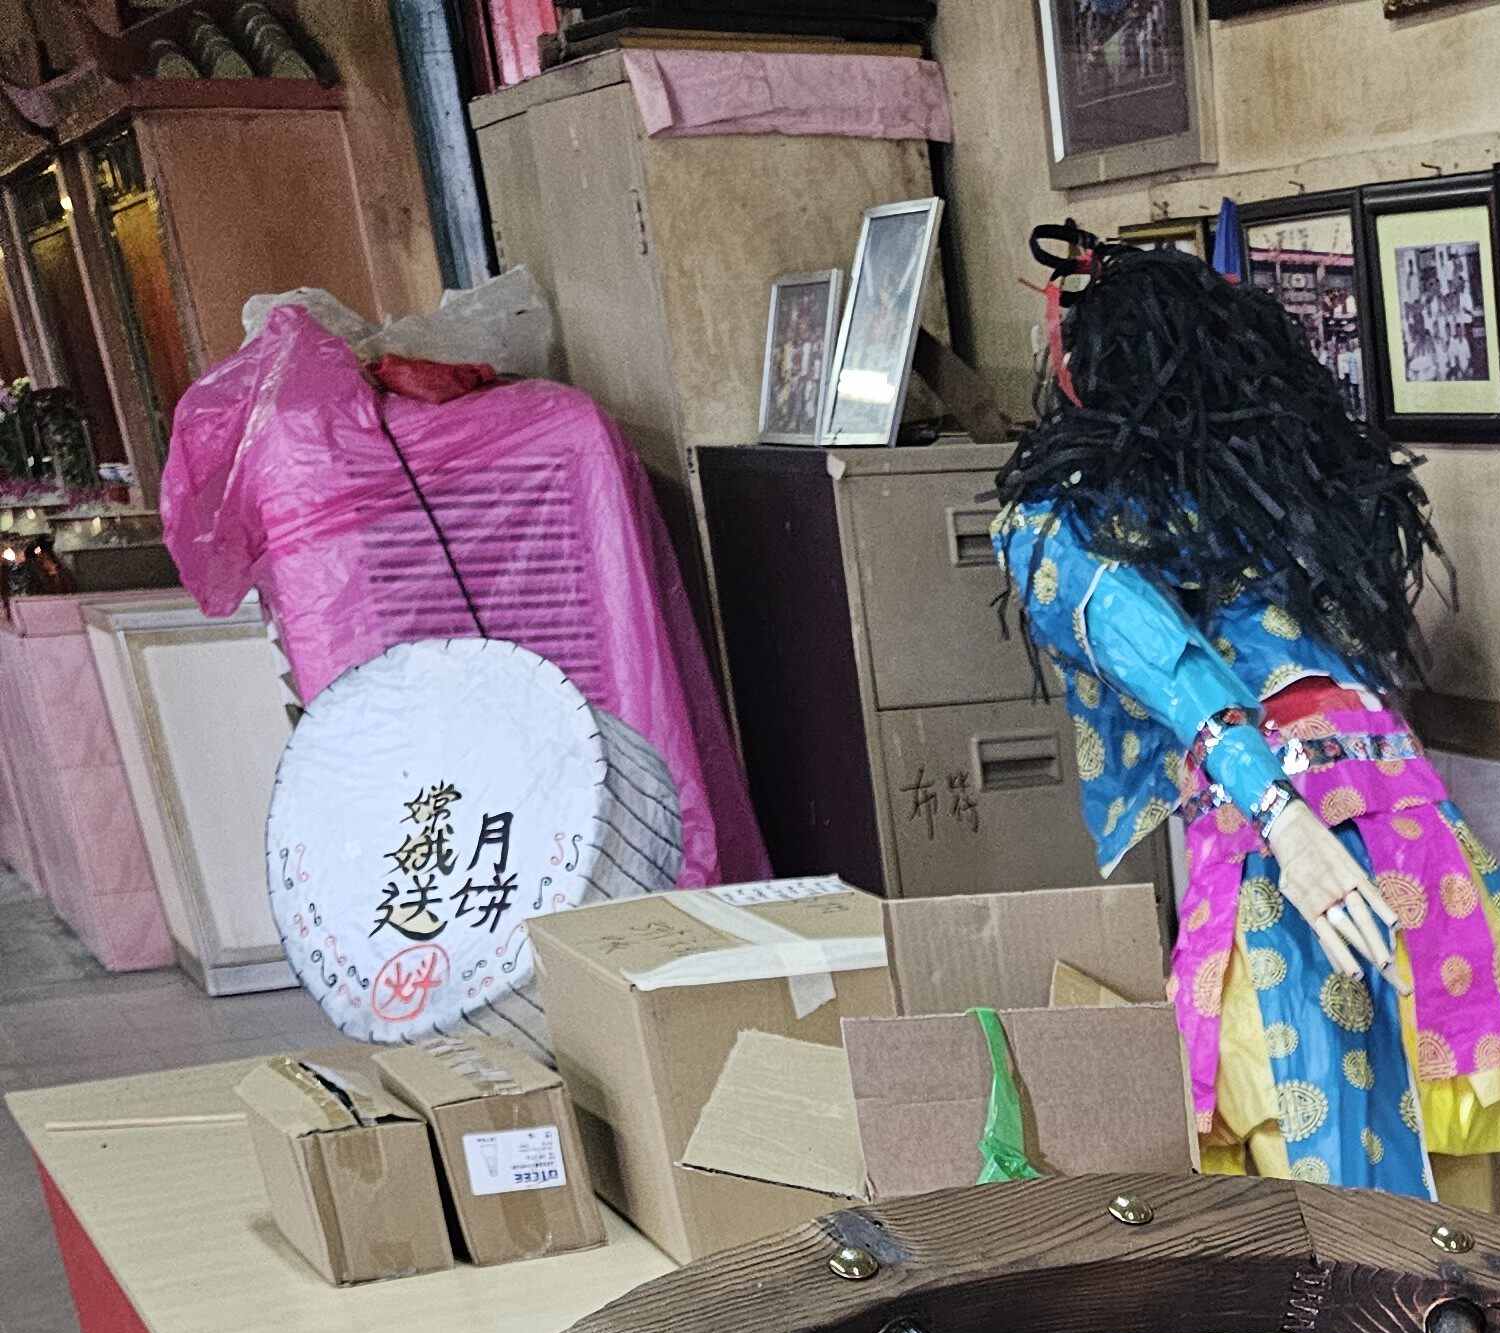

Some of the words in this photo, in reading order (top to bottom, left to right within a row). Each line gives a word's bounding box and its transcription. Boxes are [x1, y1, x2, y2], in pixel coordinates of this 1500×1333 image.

[368, 779, 463, 941] 嫦娥送
[449, 811, 519, 933] 月饼
